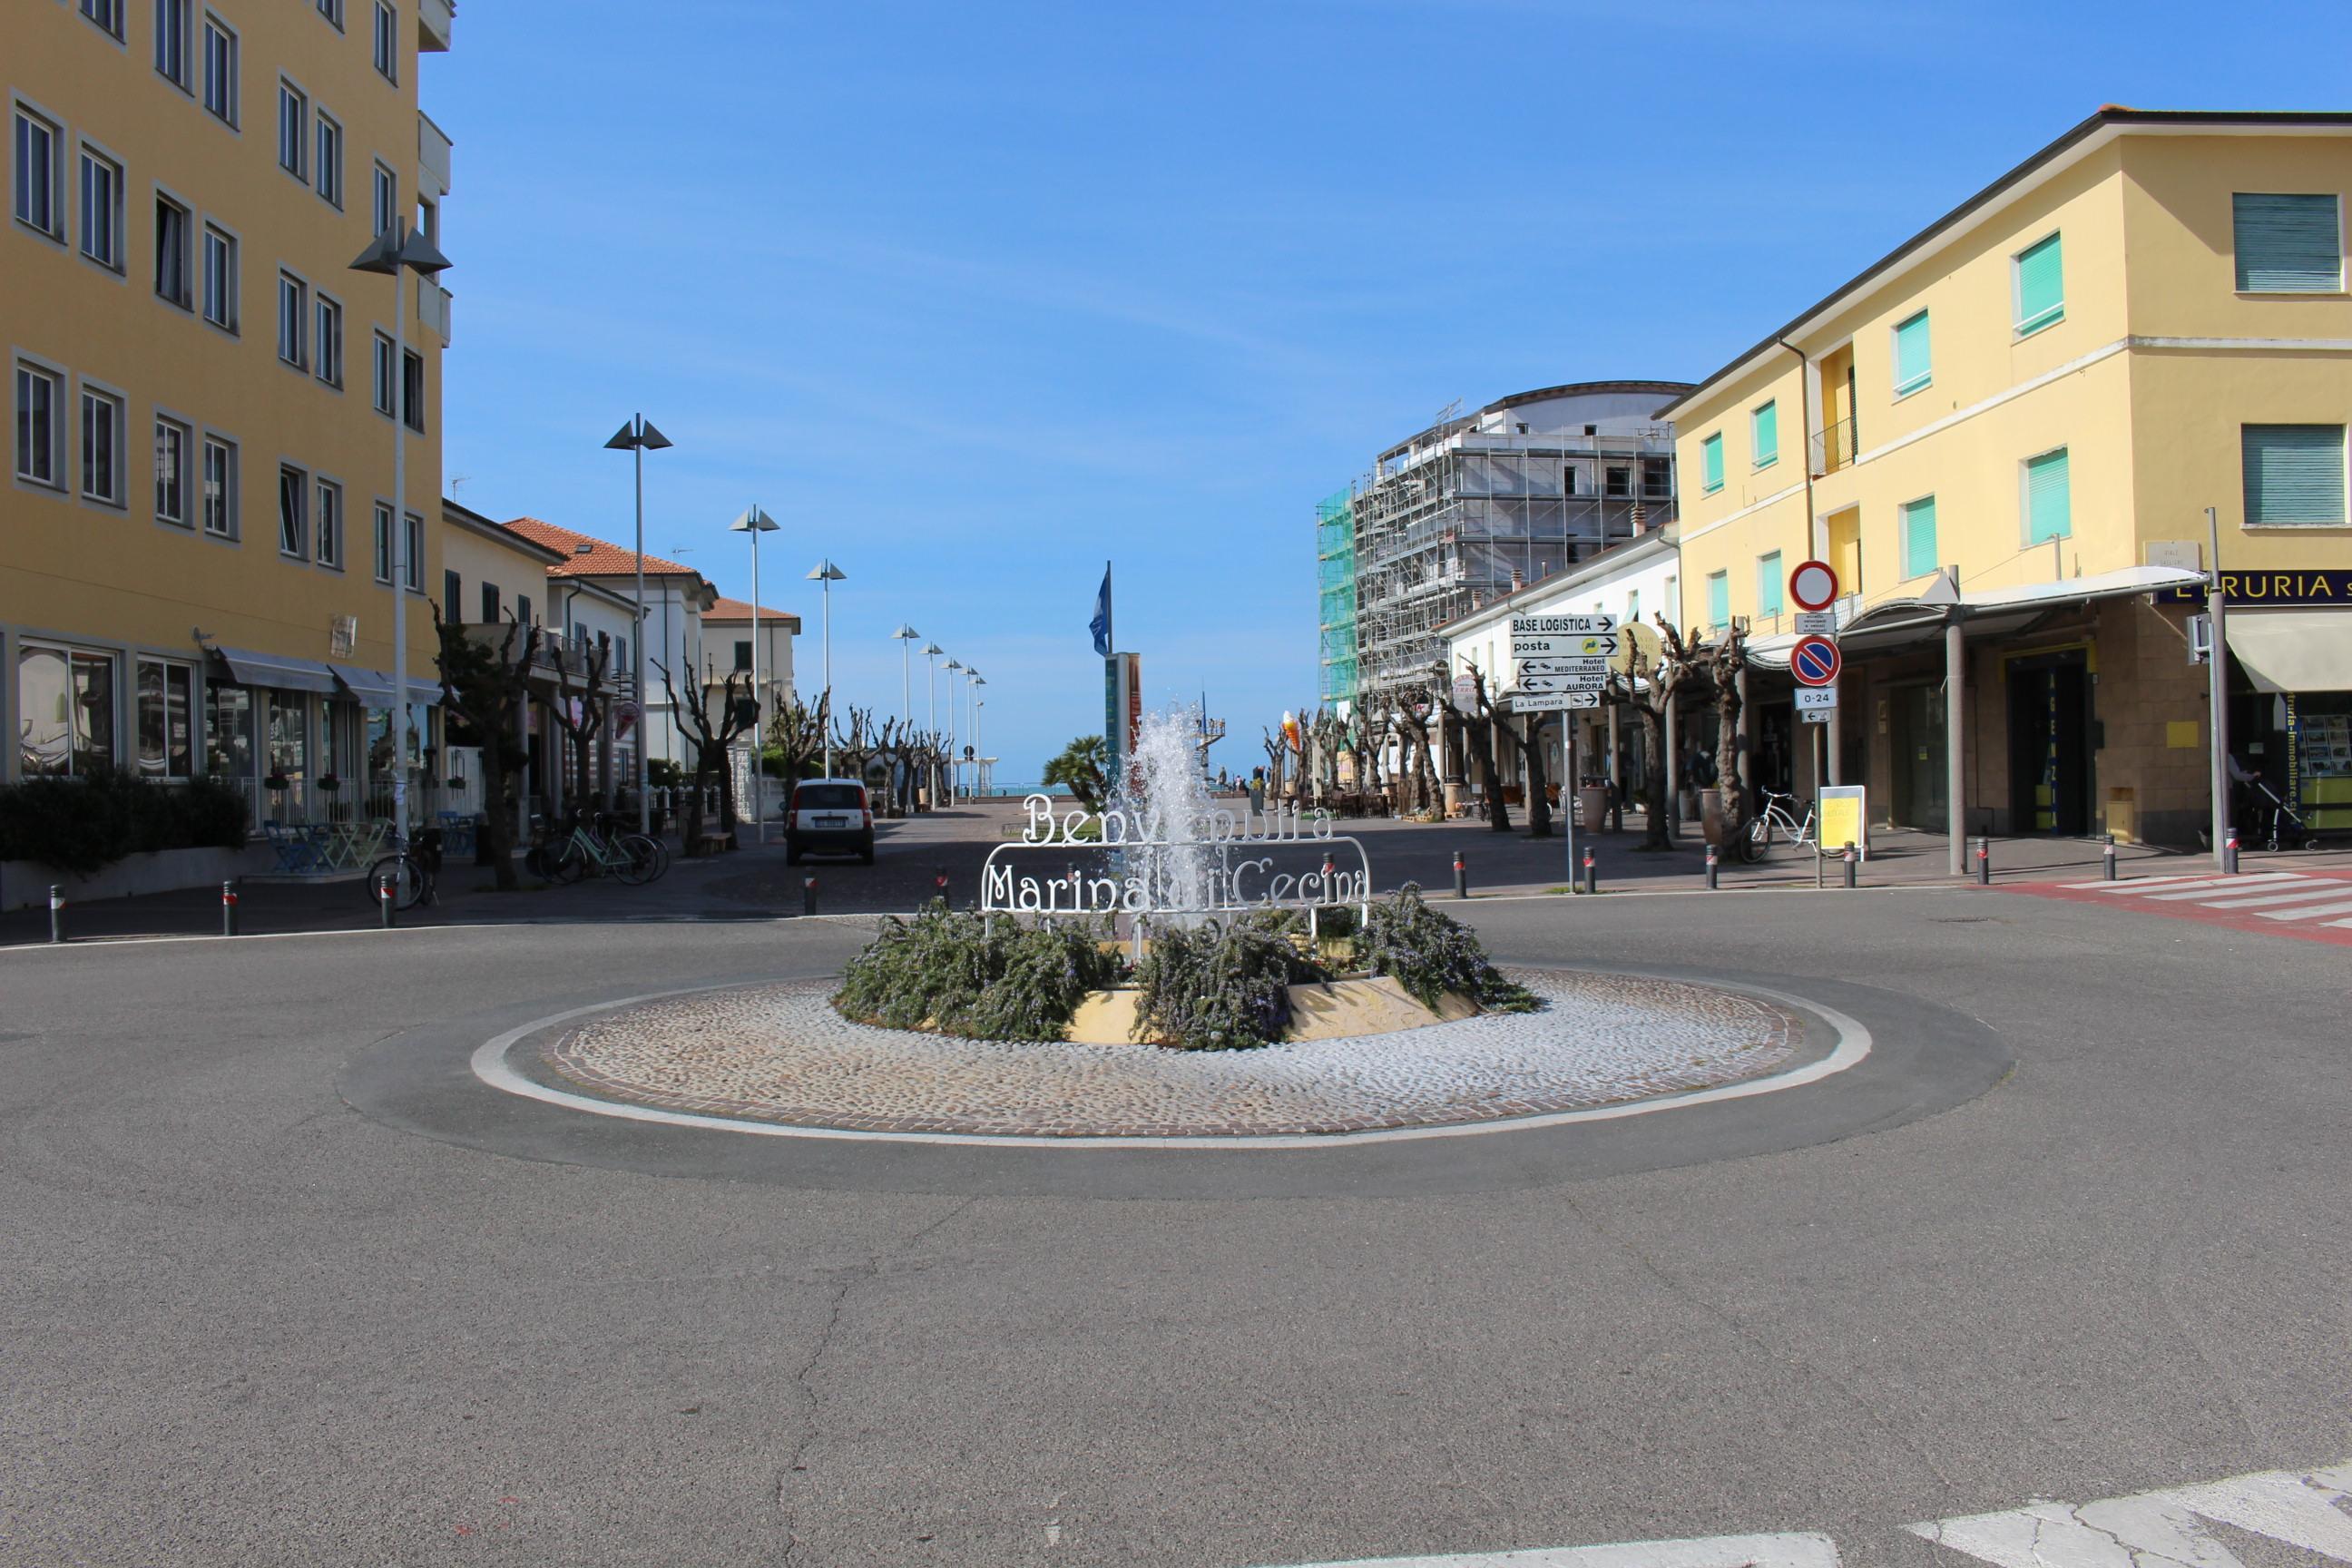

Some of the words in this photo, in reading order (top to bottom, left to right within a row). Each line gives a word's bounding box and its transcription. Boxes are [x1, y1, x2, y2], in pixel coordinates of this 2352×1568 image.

[2177, 575, 2333, 598] ERURIA
[1513, 619, 1537, 632] BASE
[1541, 618, 1591, 632] LOGISTICA
[1514, 641, 1551, 652] posta
[1515, 700, 1524, 708] La
[1528, 699, 1563, 707] Lampara
[1804, 694, 1829, 703] 0-24
[2287, 691, 2298, 813] truria-immobiliare.c
[1313, 806, 1335, 841] a
[987, 864, 1151, 911] Marina
[1232, 858, 1369, 908] Cecina
